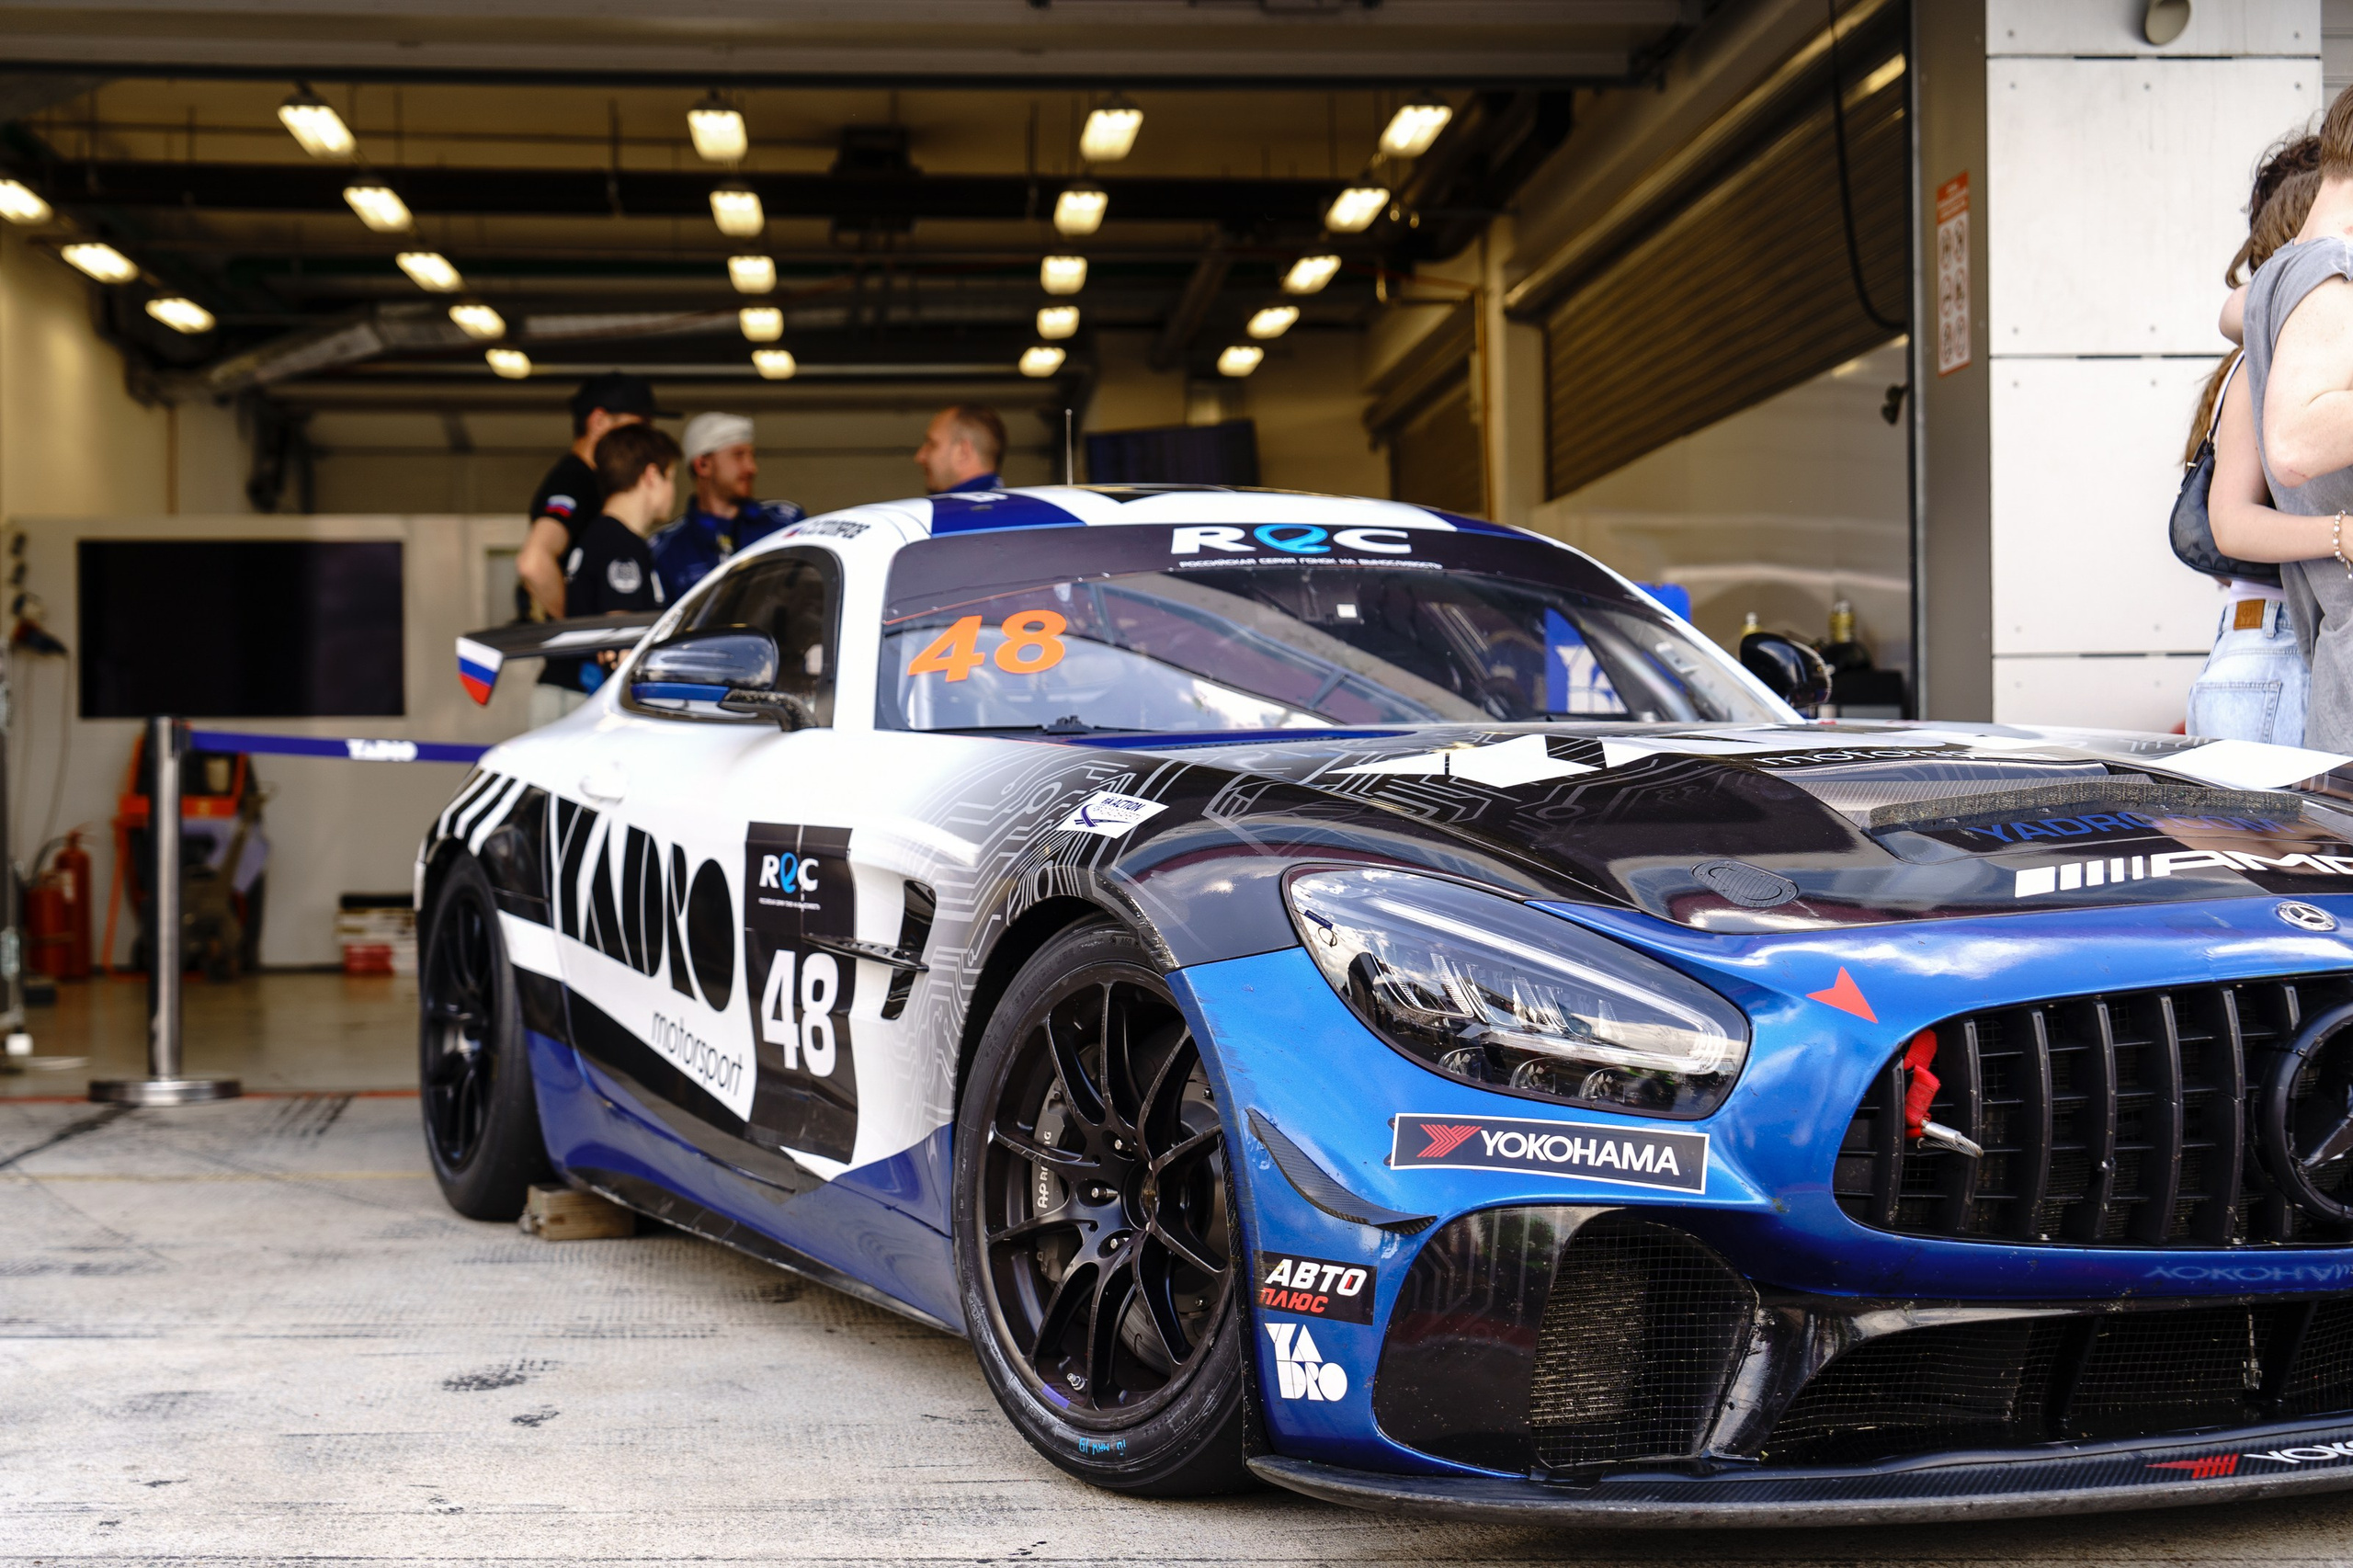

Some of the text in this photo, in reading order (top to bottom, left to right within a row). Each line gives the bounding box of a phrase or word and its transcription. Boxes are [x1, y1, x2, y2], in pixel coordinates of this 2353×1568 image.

[907, 609, 1067, 682] 48
[557, 794, 735, 1013] YADRO
[761, 949, 838, 1078] 48
[652, 1011, 744, 1096] motorsport
[1481, 1130, 1680, 1176] YOKOHAMA
[1259, 1288, 1329, 1313] ПЛЮС
[1264, 1258, 1368, 1297] АВТО
[2243, 1440, 2353, 1464] YOK
